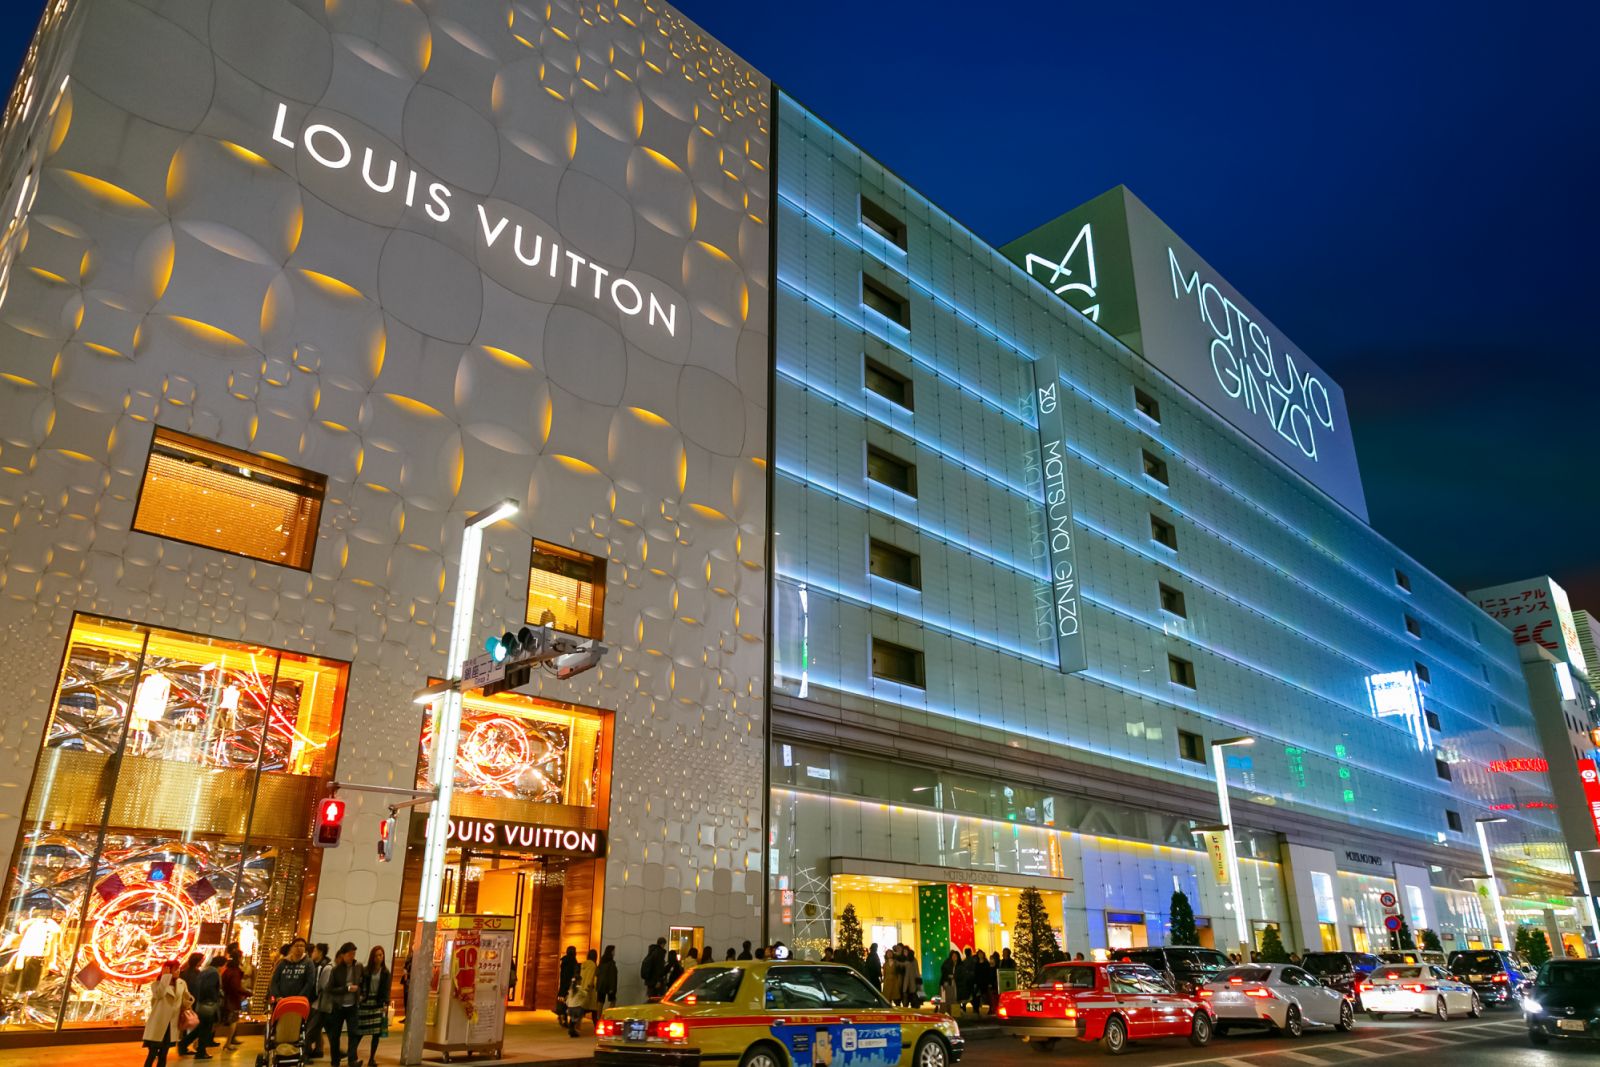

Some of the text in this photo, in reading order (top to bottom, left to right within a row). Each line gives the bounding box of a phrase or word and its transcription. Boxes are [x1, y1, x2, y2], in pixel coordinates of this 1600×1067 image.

[272, 103, 676, 337] LOUIS VUITTON
[1168, 247, 1335, 432] MATSUYA
[1210, 339, 1318, 462] GINZA
[1043, 440, 1079, 637] MATSUYA GINZA
[425, 818, 596, 852] OUIS VUITTON
